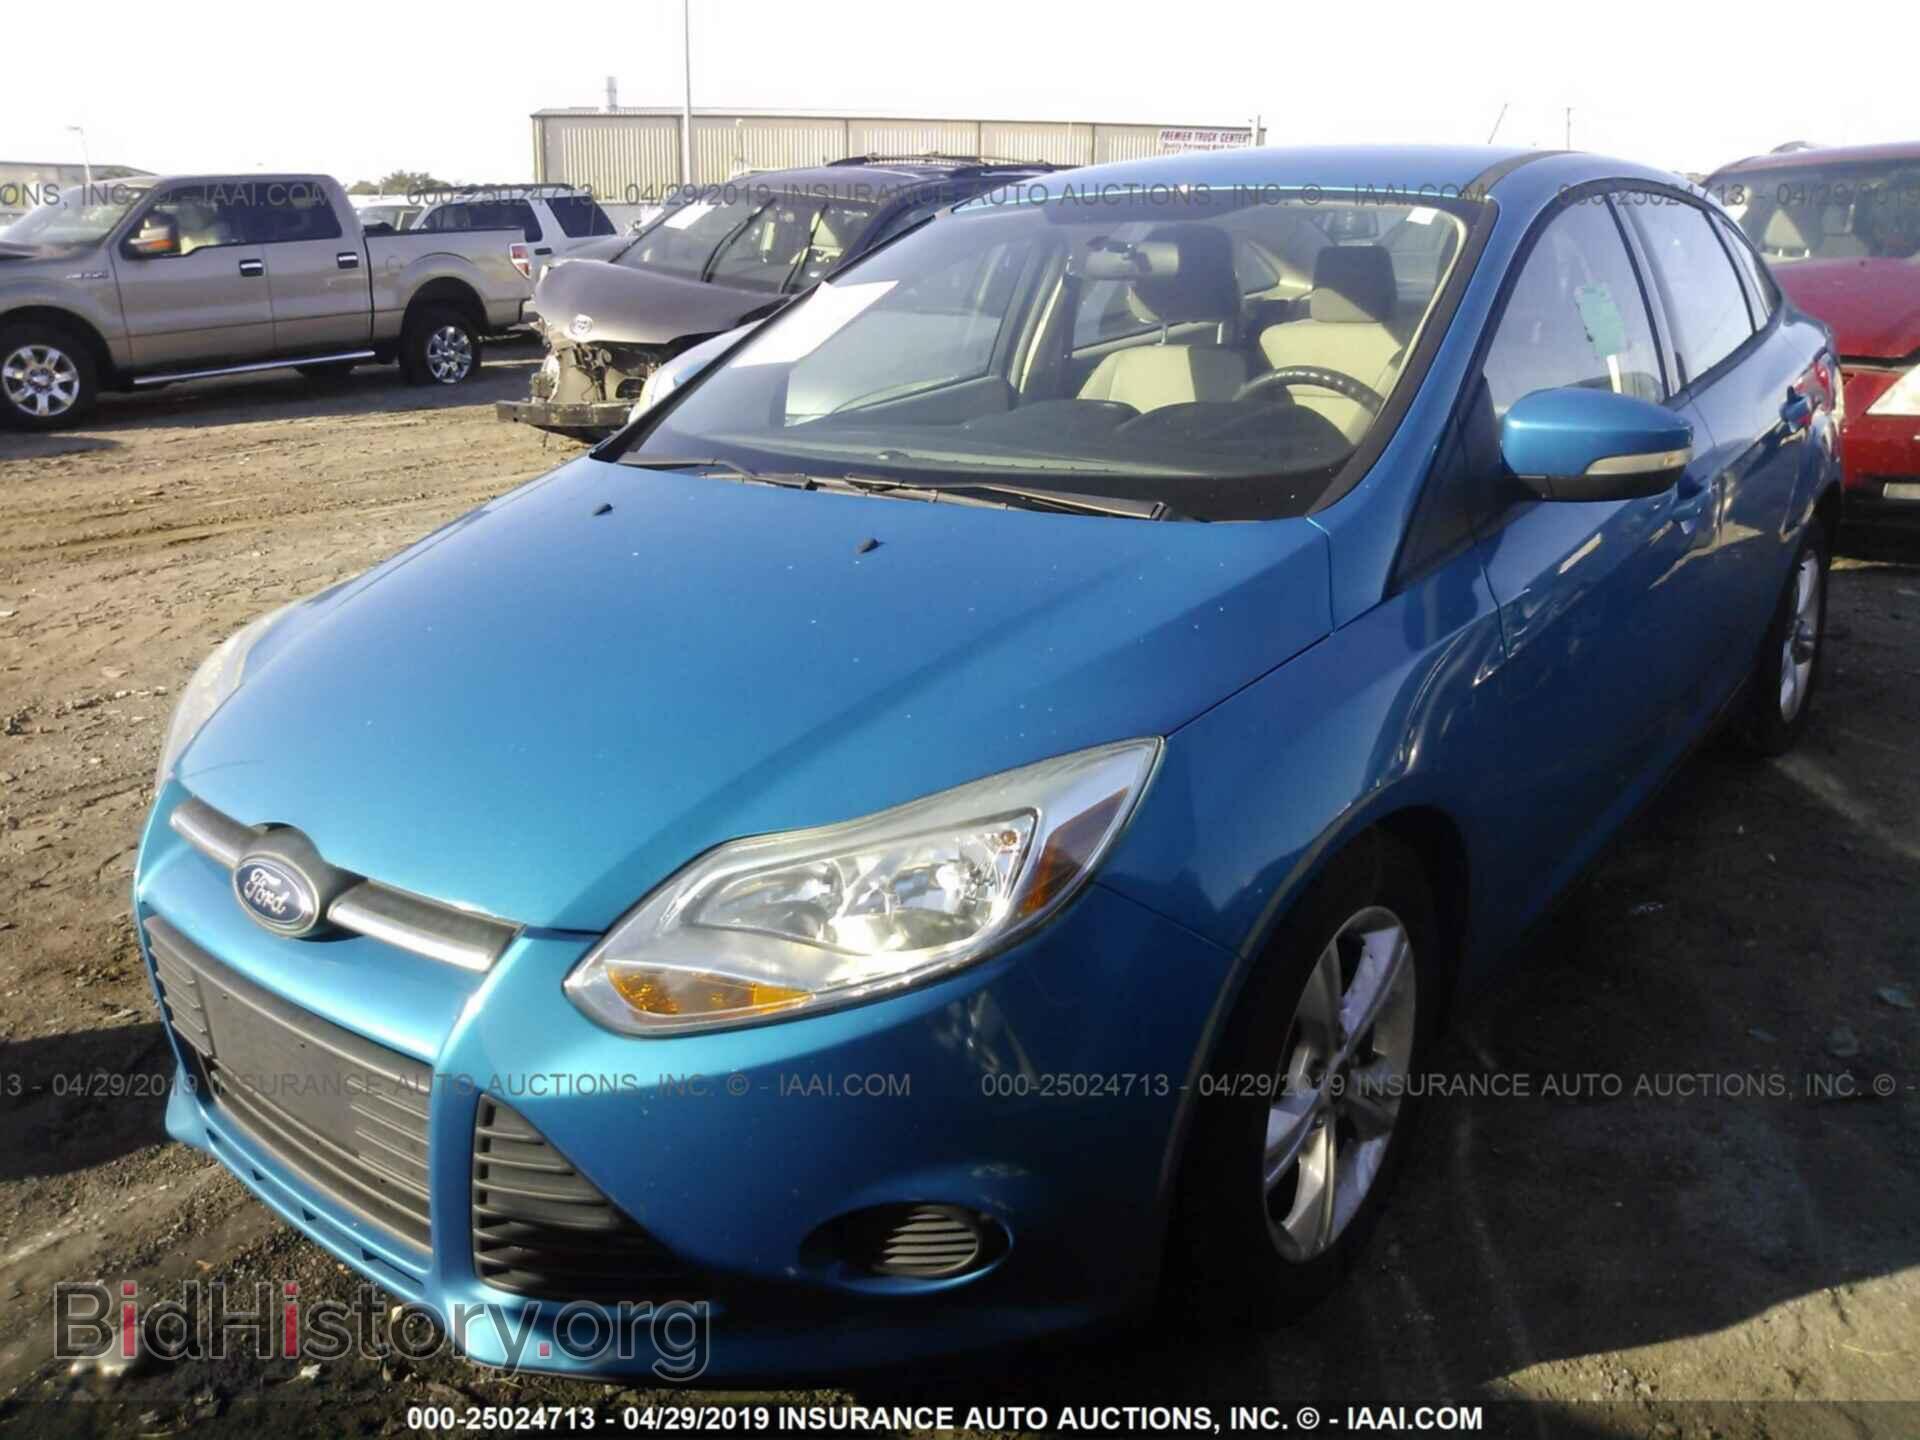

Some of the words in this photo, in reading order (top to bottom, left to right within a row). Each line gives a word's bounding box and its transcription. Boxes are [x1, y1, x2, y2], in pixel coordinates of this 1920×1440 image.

[1160, 130, 1192, 142] PREMIER
[1194, 131, 1217, 142] TRUCK
[1220, 132, 1248, 143] CENTER
[244, 867, 290, 915] Ford
